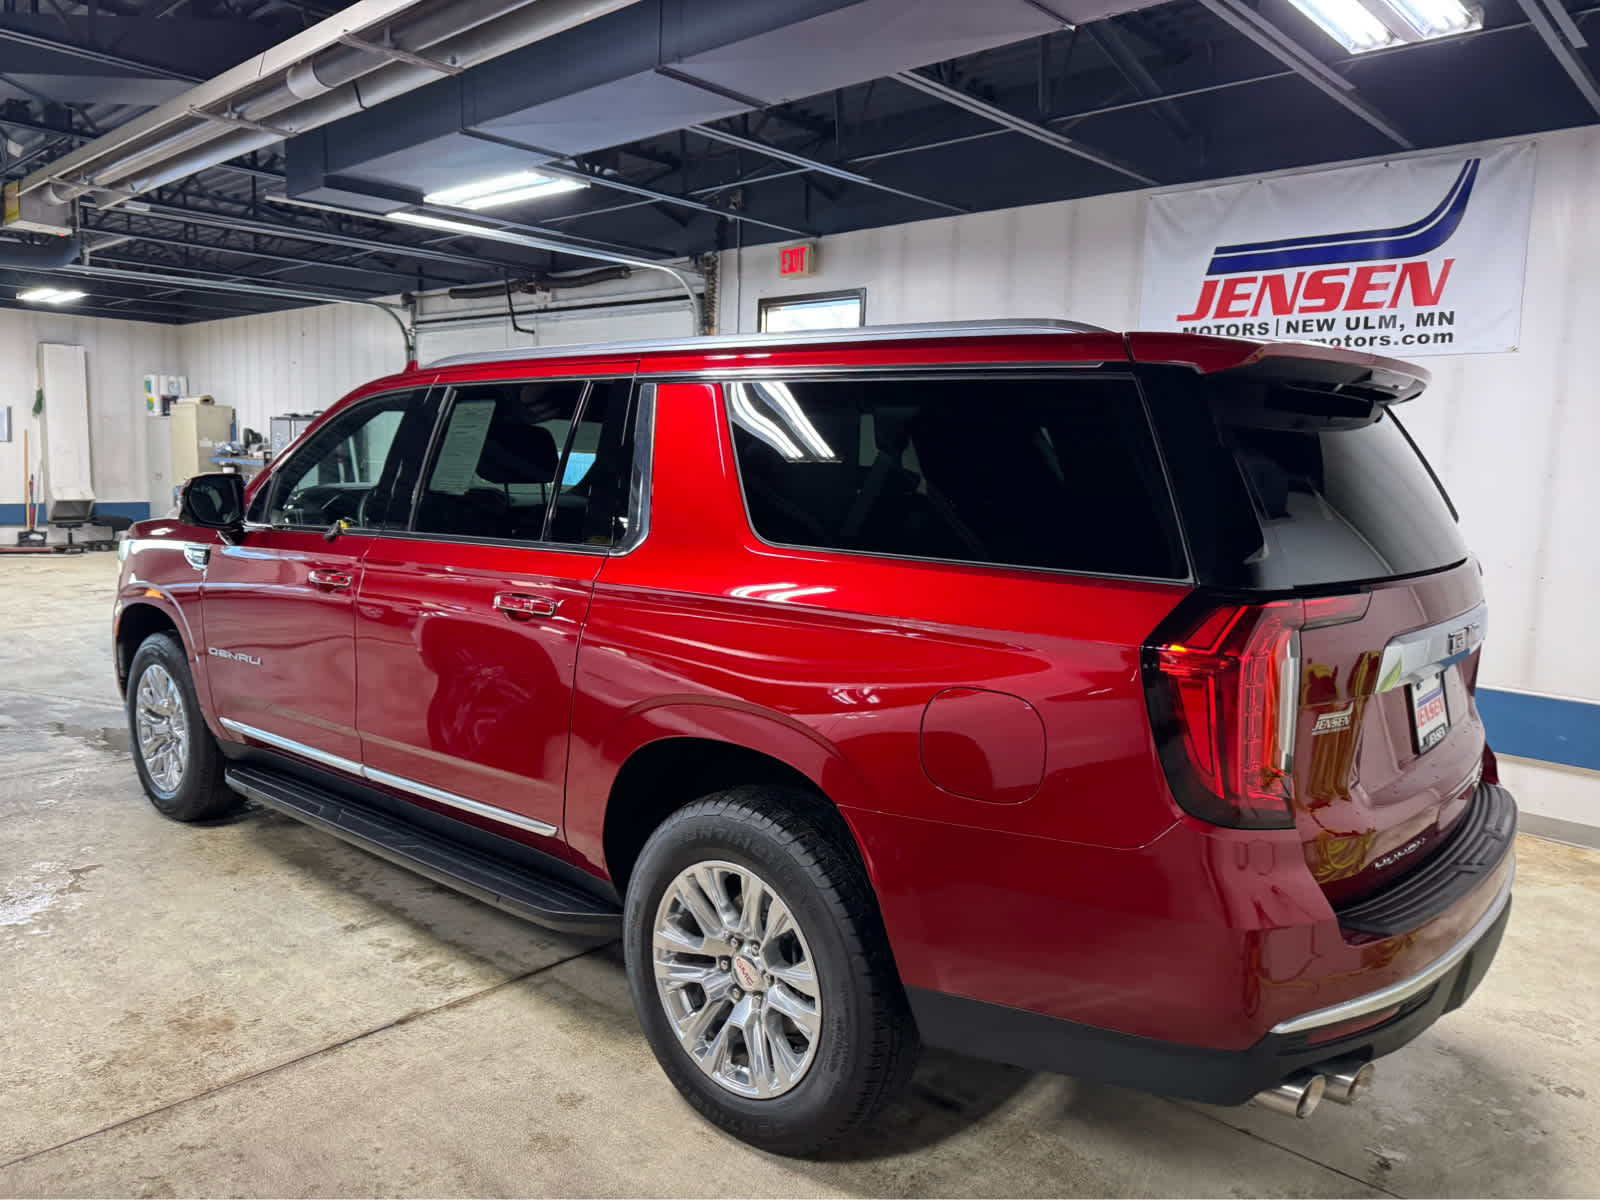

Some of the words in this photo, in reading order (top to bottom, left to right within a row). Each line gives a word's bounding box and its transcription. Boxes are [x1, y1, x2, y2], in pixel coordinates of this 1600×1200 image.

[781, 246, 807, 275] EXIT
[1176, 258, 1456, 322] JENSEN
[1286, 318, 1336, 334] NEW
[1345, 314, 1405, 332] ULM,
[1415, 311, 1455, 327] MN
[1311, 715, 1351, 731] JENSEN
[736, 958, 754, 986] GMC
